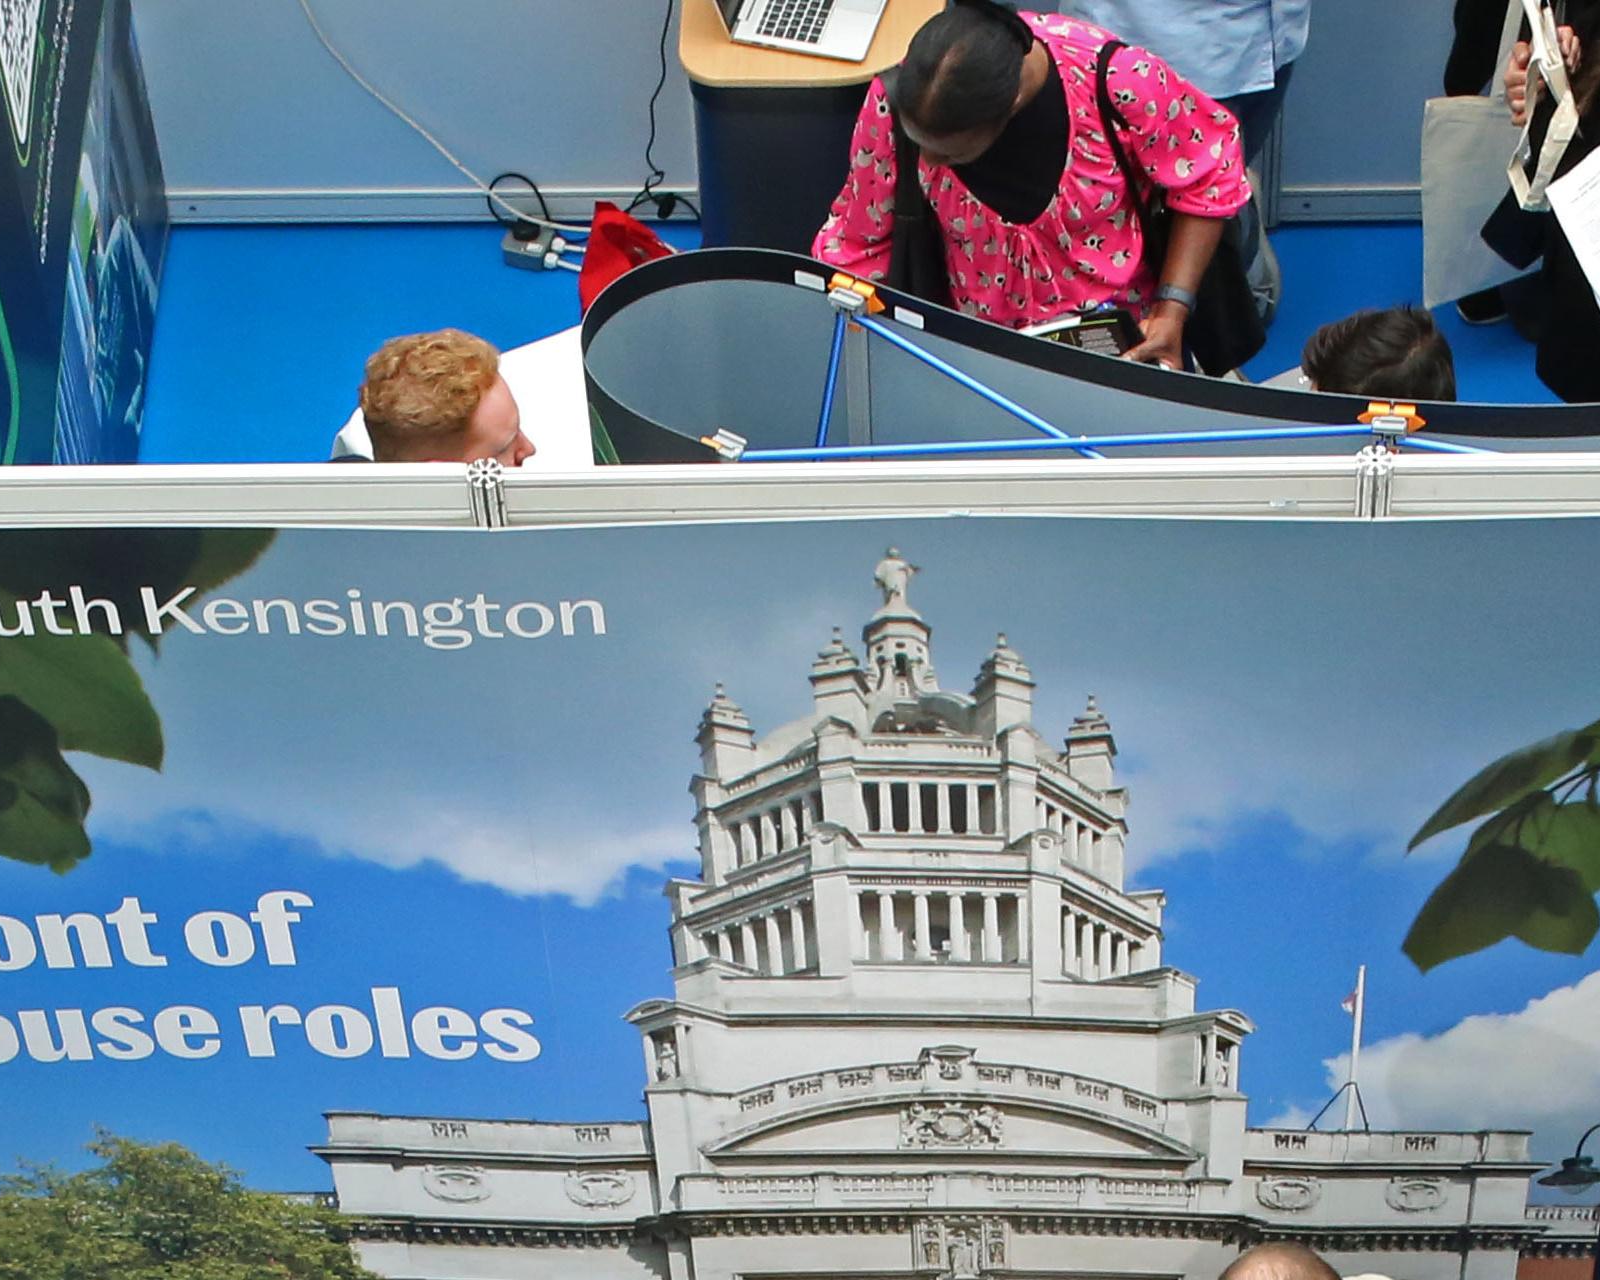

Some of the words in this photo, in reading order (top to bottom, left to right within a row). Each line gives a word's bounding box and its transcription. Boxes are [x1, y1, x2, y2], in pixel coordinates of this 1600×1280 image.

[140, 586, 606, 650] Kensington
[186, 890, 315, 968] of
[242, 986, 543, 1064] roles
